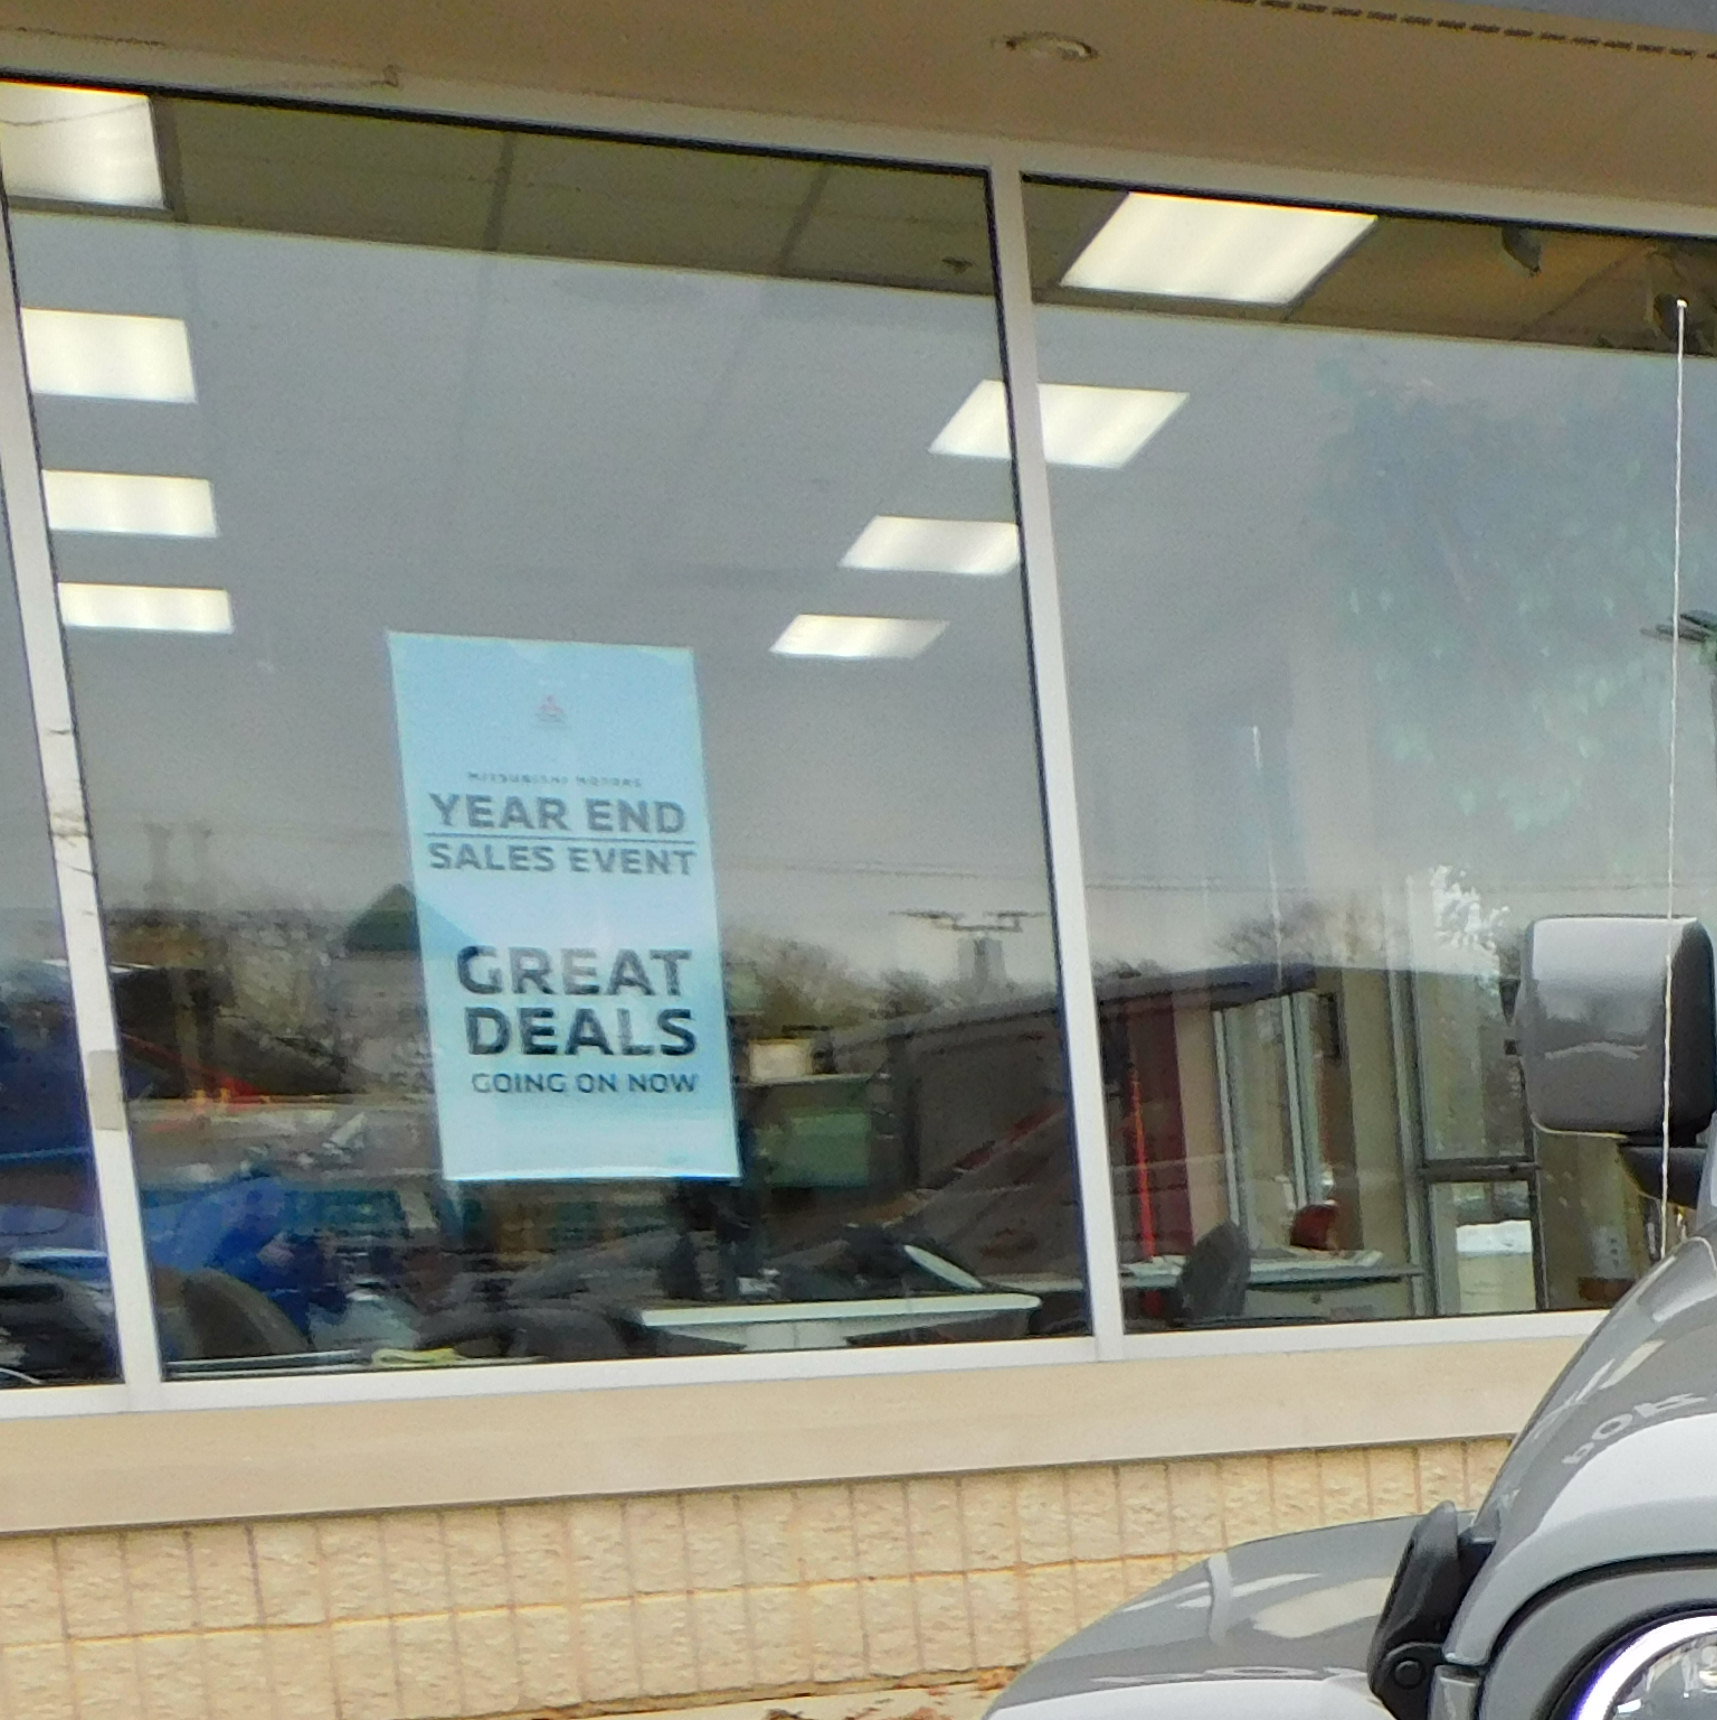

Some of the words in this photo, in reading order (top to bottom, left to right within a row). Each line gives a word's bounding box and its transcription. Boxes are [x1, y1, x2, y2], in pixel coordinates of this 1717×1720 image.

[428, 793, 570, 832] YEAR
[585, 797, 686, 834] END
[427, 842, 555, 872] SALES
[567, 847, 697, 876] EVENT
[456, 945, 694, 996] GREAT
[463, 1006, 698, 1056] DEALS
[471, 1072, 566, 1094] GOING
[576, 1072, 618, 1094] ON
[628, 1072, 699, 1094] NOW
